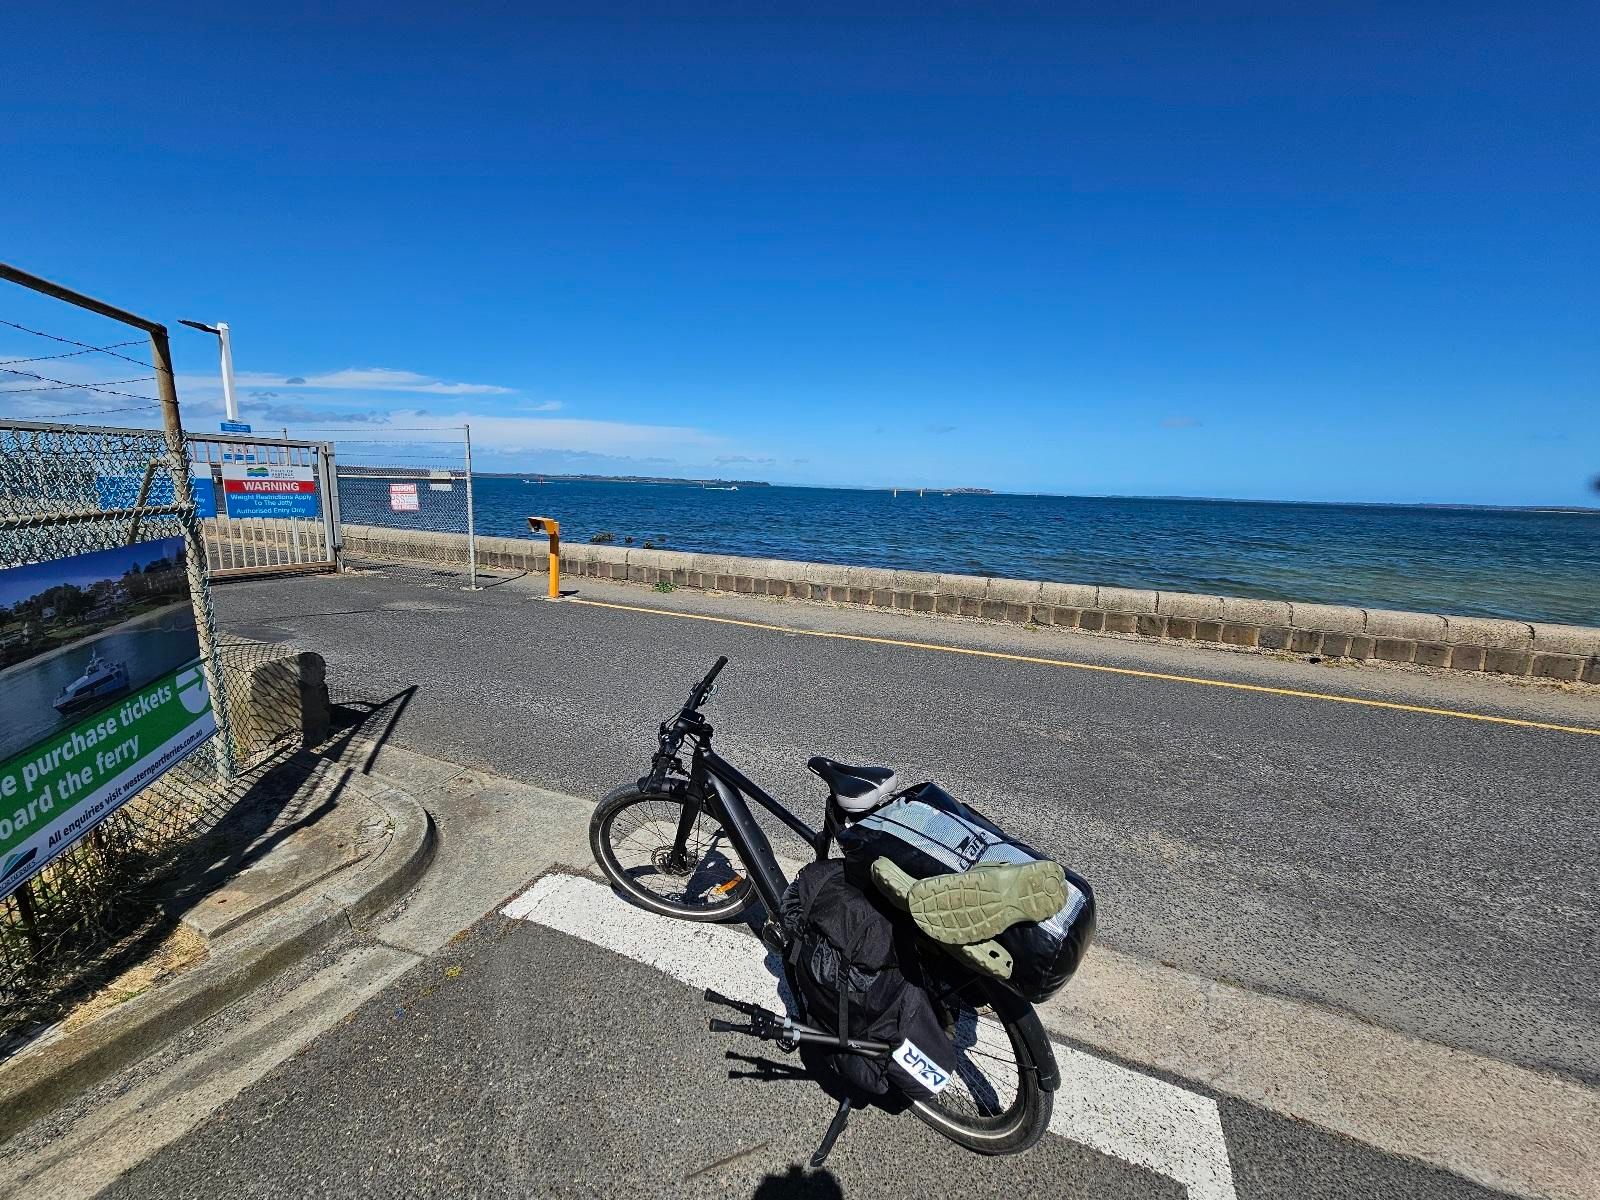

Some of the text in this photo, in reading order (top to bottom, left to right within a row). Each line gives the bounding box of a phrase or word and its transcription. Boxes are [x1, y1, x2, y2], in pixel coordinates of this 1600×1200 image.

[242, 481, 300, 491] WARNING
[0, 684, 173, 799] e purchase tickets
[0, 734, 139, 840] oard the ferry
[48, 728, 203, 848] All enquiries visit westernportferries.com.au
[903, 1046, 947, 1087] AZUR
